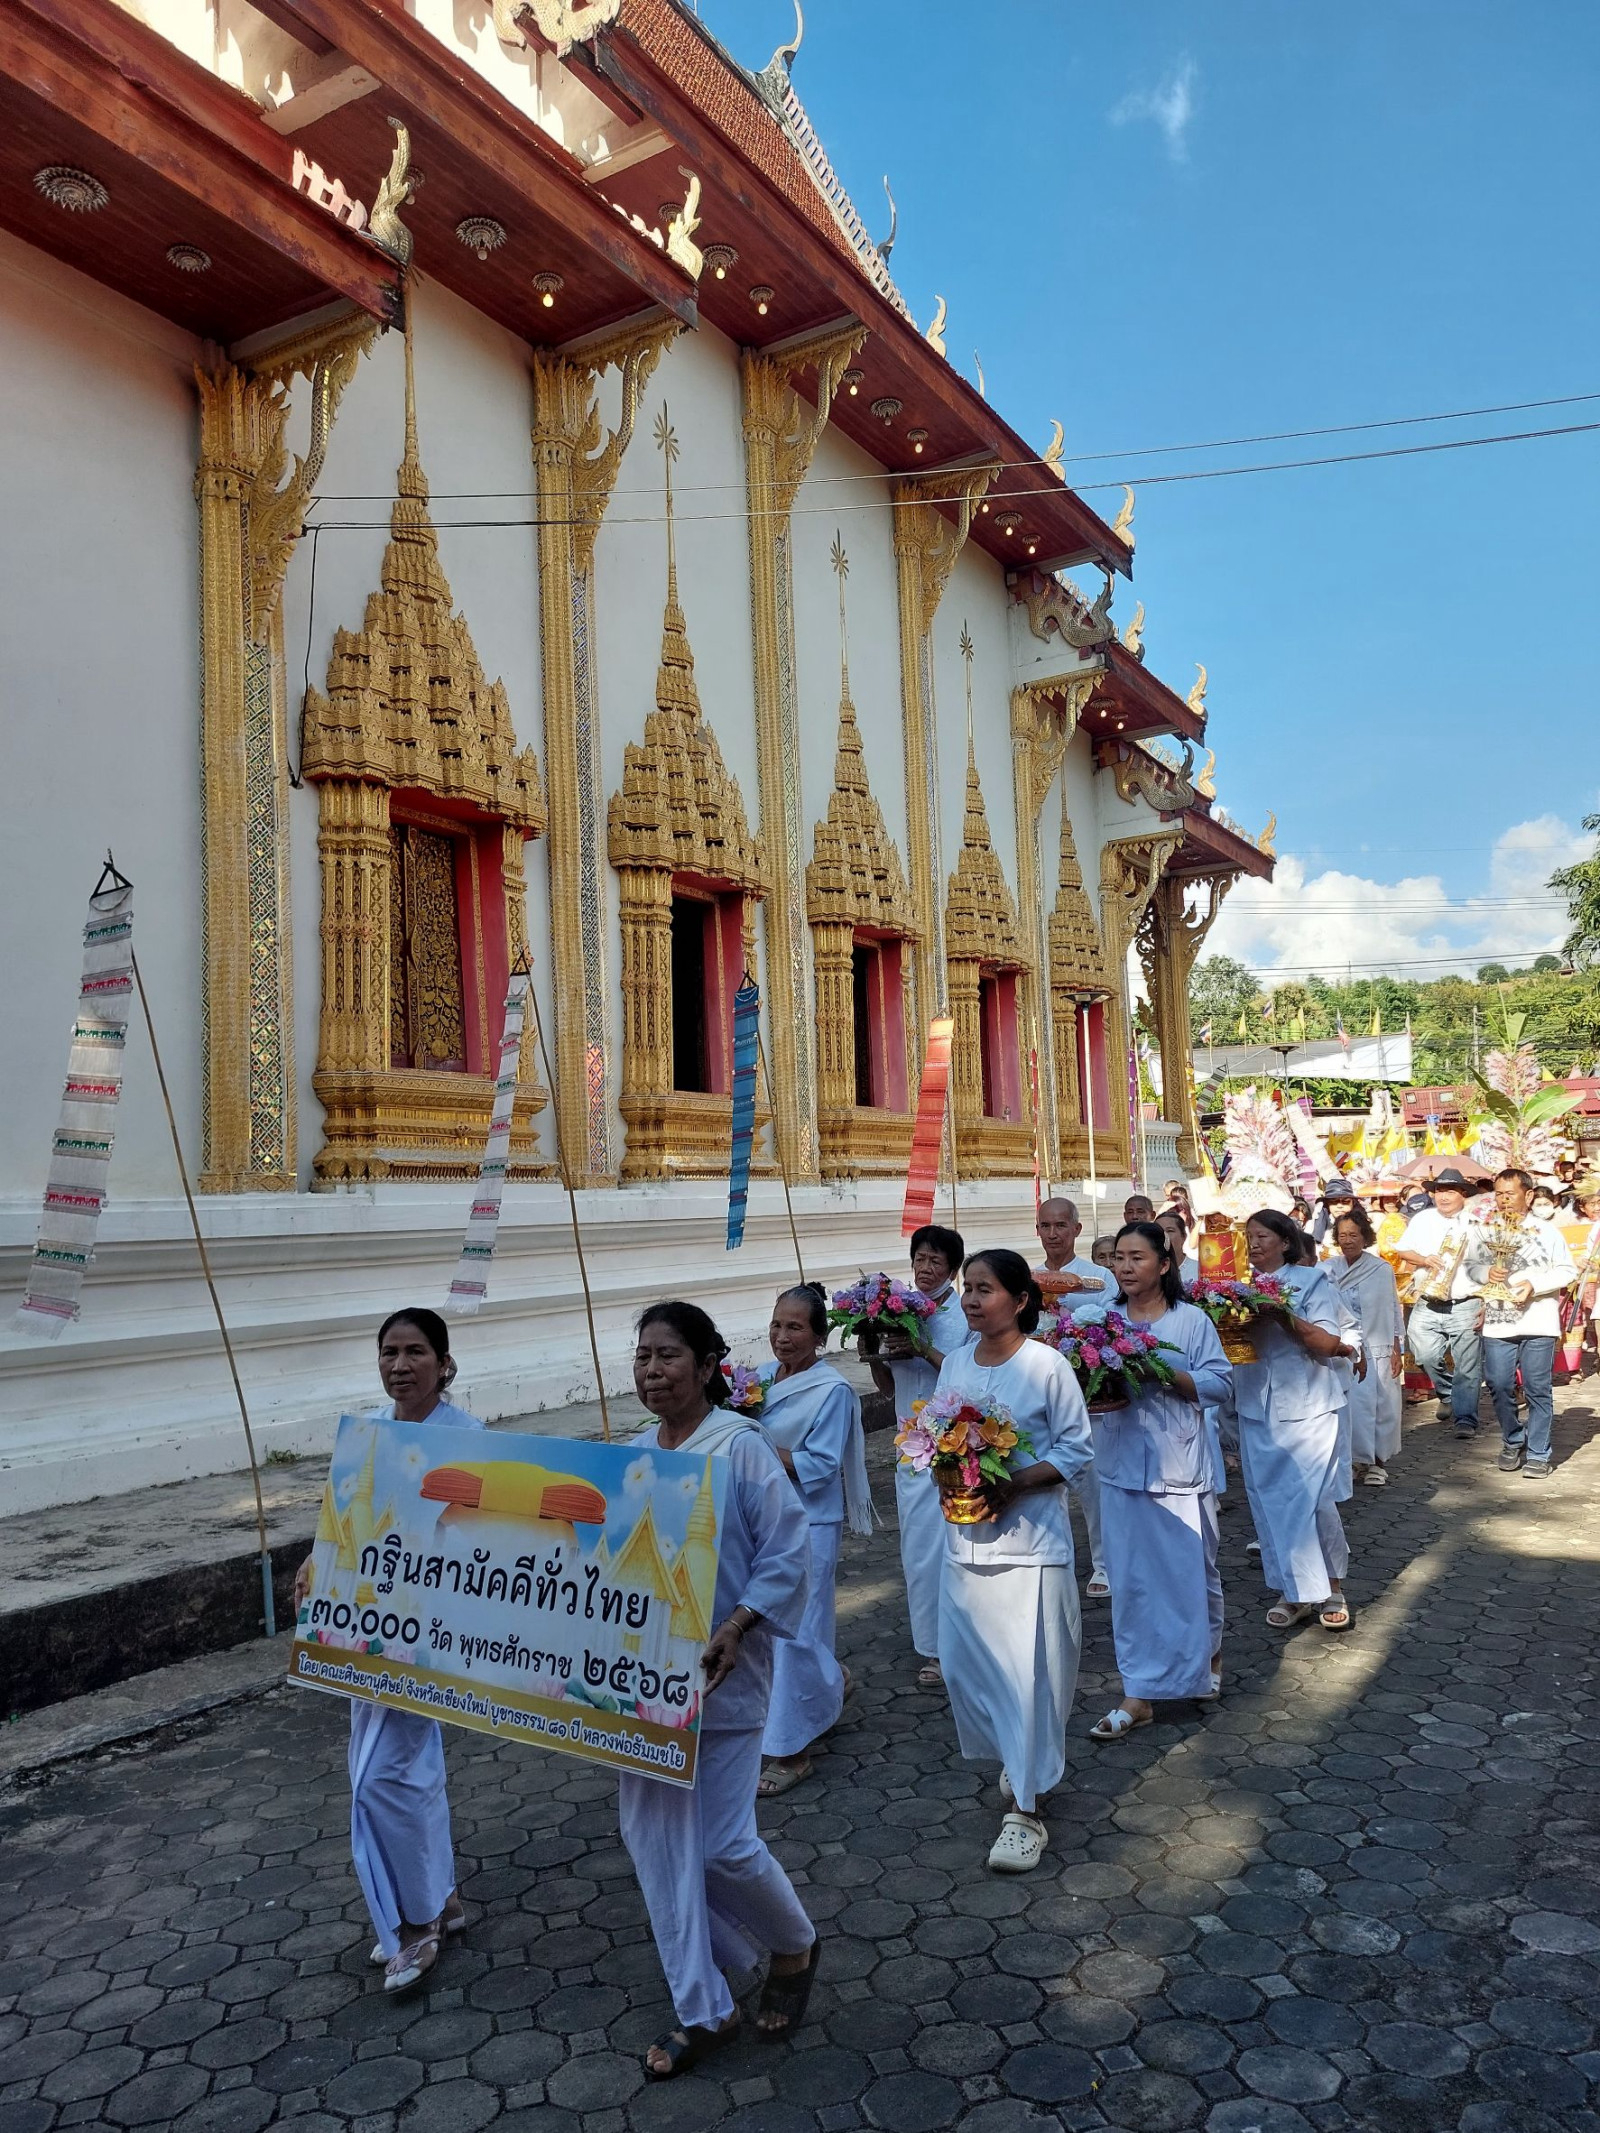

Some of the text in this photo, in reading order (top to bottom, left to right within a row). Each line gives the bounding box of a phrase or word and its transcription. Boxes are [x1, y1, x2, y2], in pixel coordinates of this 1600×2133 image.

[360, 1533, 649, 1629] กฐินสามัคคีทั่วไทย
[299, 1653, 318, 1674] โดย
[406, 1680, 489, 1717] จังหวัดเชียงใหม่
[491, 1704, 546, 1731] บูชาธรรม
[549, 1721, 566, 1737] ๘๑
[571, 1719, 581, 1740] ปี
[311, 1599, 690, 1707] ๓๐,๐๐๐ วัด พุทธศักราช ๒๕๖๘
